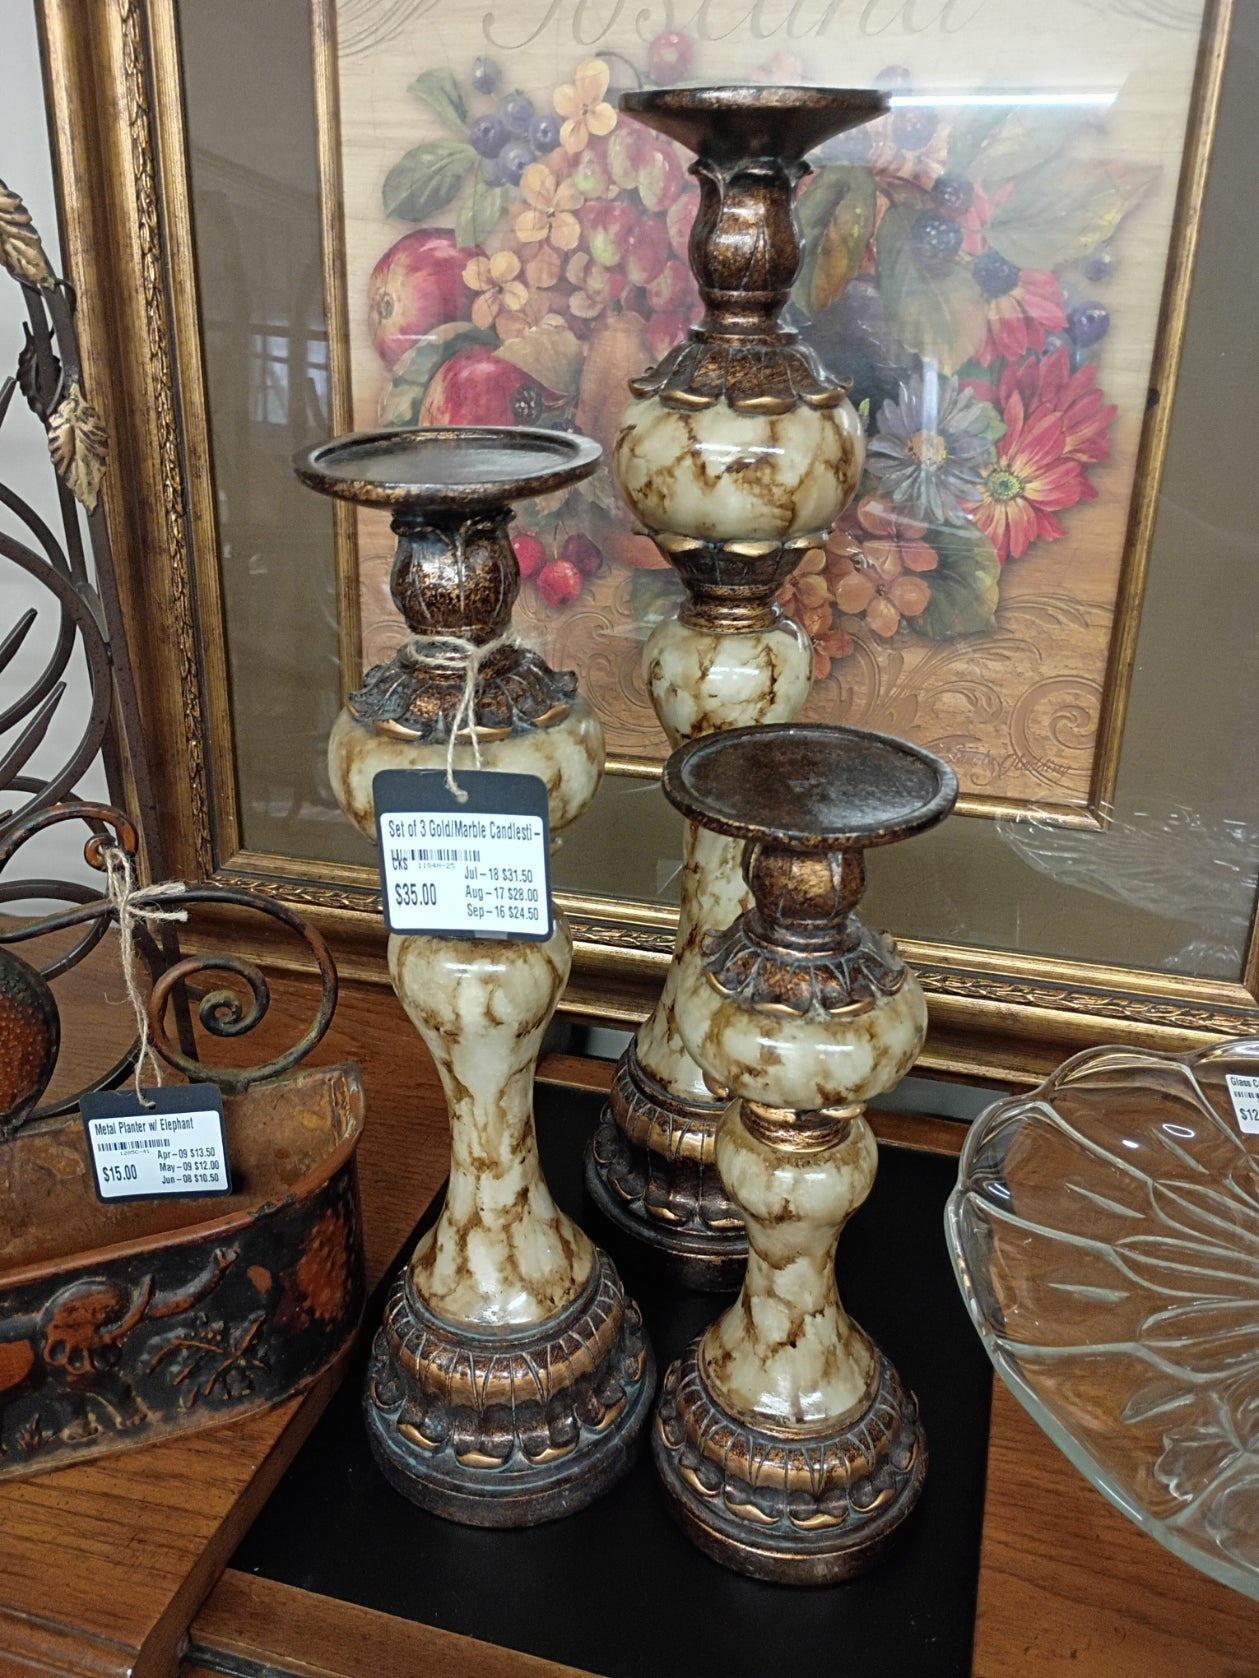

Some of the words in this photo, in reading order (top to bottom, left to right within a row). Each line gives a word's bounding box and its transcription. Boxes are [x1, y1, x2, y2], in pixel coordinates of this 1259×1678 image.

[388, 820, 405, 838] Set
[408, 820, 417, 837] of
[420, 820, 426, 837] 3
[429, 820, 486, 839] Gold/Marble
[502, 867, 533, 884] $31.50
[394, 882, 437, 908] $35.00
[507, 887, 539, 902] $28.00
[508, 906, 539, 921] $24.50
[1230, 1076, 1252, 1088] Glass
[95, 1123, 117, 1136] Metal
[119, 1121, 146, 1134] Planter
[148, 1120, 158, 1132] w/
[160, 1117, 194, 1133] Elephant
[190, 1147, 216, 1159] $13.50
[194, 1160, 220, 1171] $12.00
[102, 1164, 138, 1184] $15.00
[194, 1173, 220, 1184] $10.50
